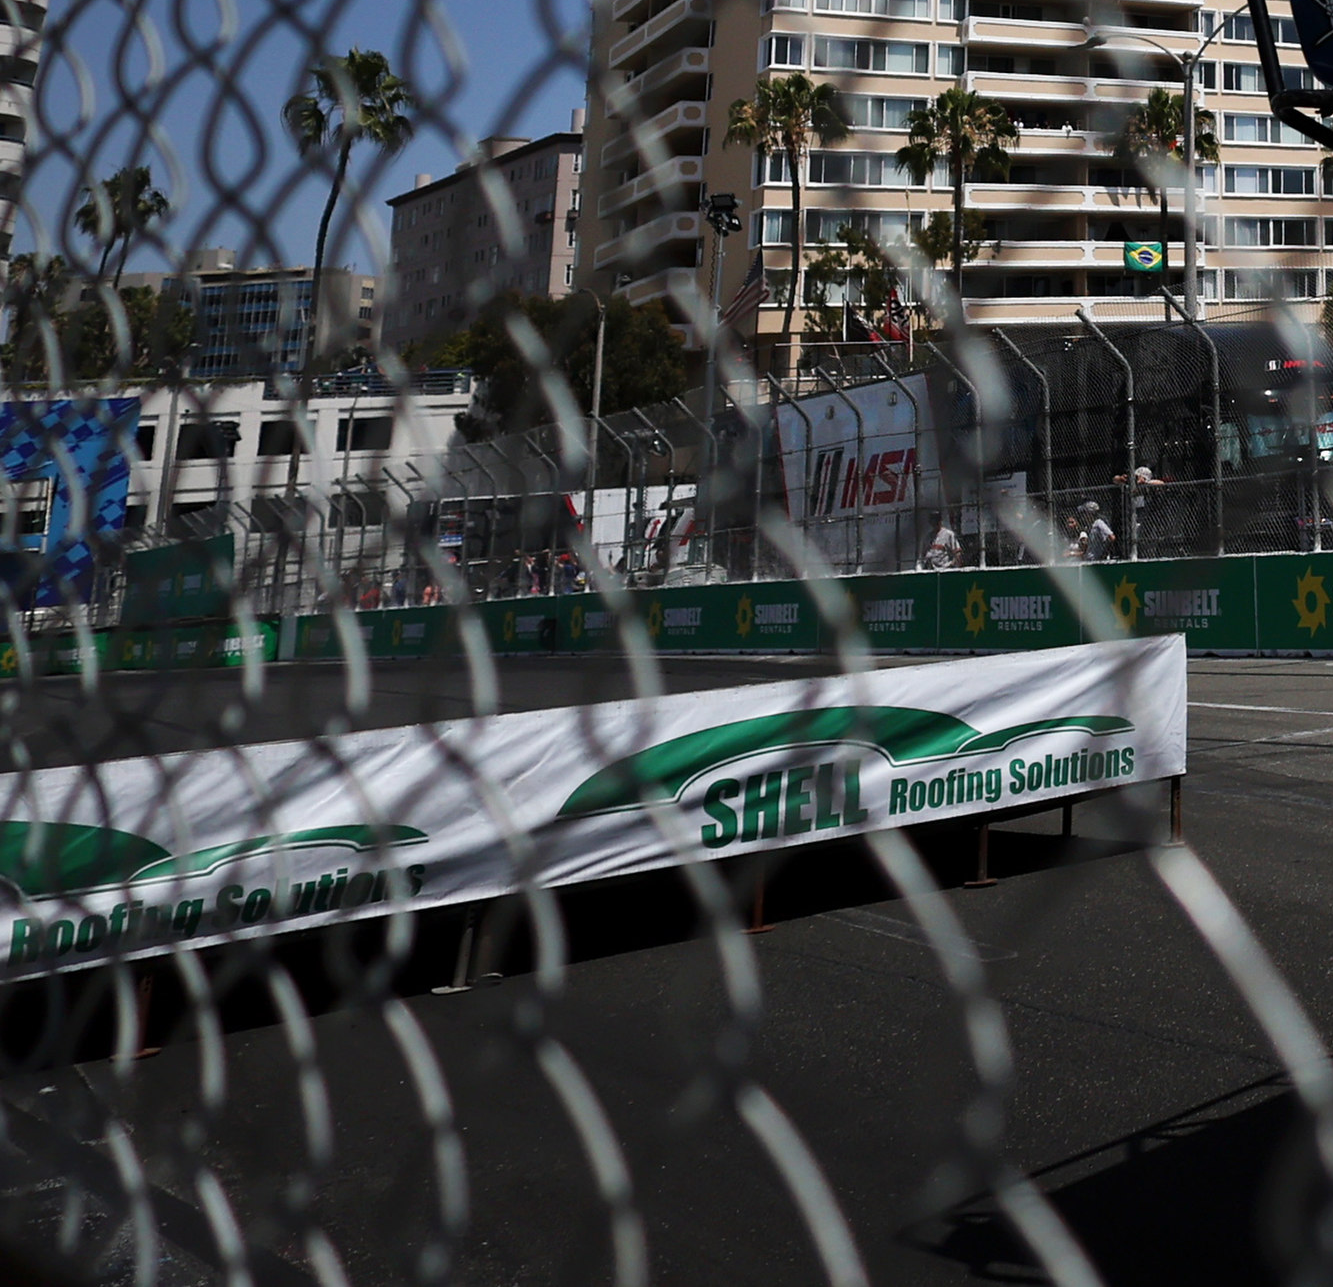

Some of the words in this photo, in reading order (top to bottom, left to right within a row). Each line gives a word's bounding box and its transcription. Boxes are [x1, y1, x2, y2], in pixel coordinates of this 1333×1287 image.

[755, 603, 800, 624] SUNBELT
[990, 596, 1052, 619] SUNBELT
[1144, 588, 1220, 617] SUNBELT
[998, 621, 1043, 631] RENTALS
[1154, 618, 1209, 629] RENTALS
[701, 759, 870, 849] SHELL
[889, 768, 1001, 815] Roofing
[1009, 746, 1135, 795] Solutions
[212, 864, 424, 927] Soutions
